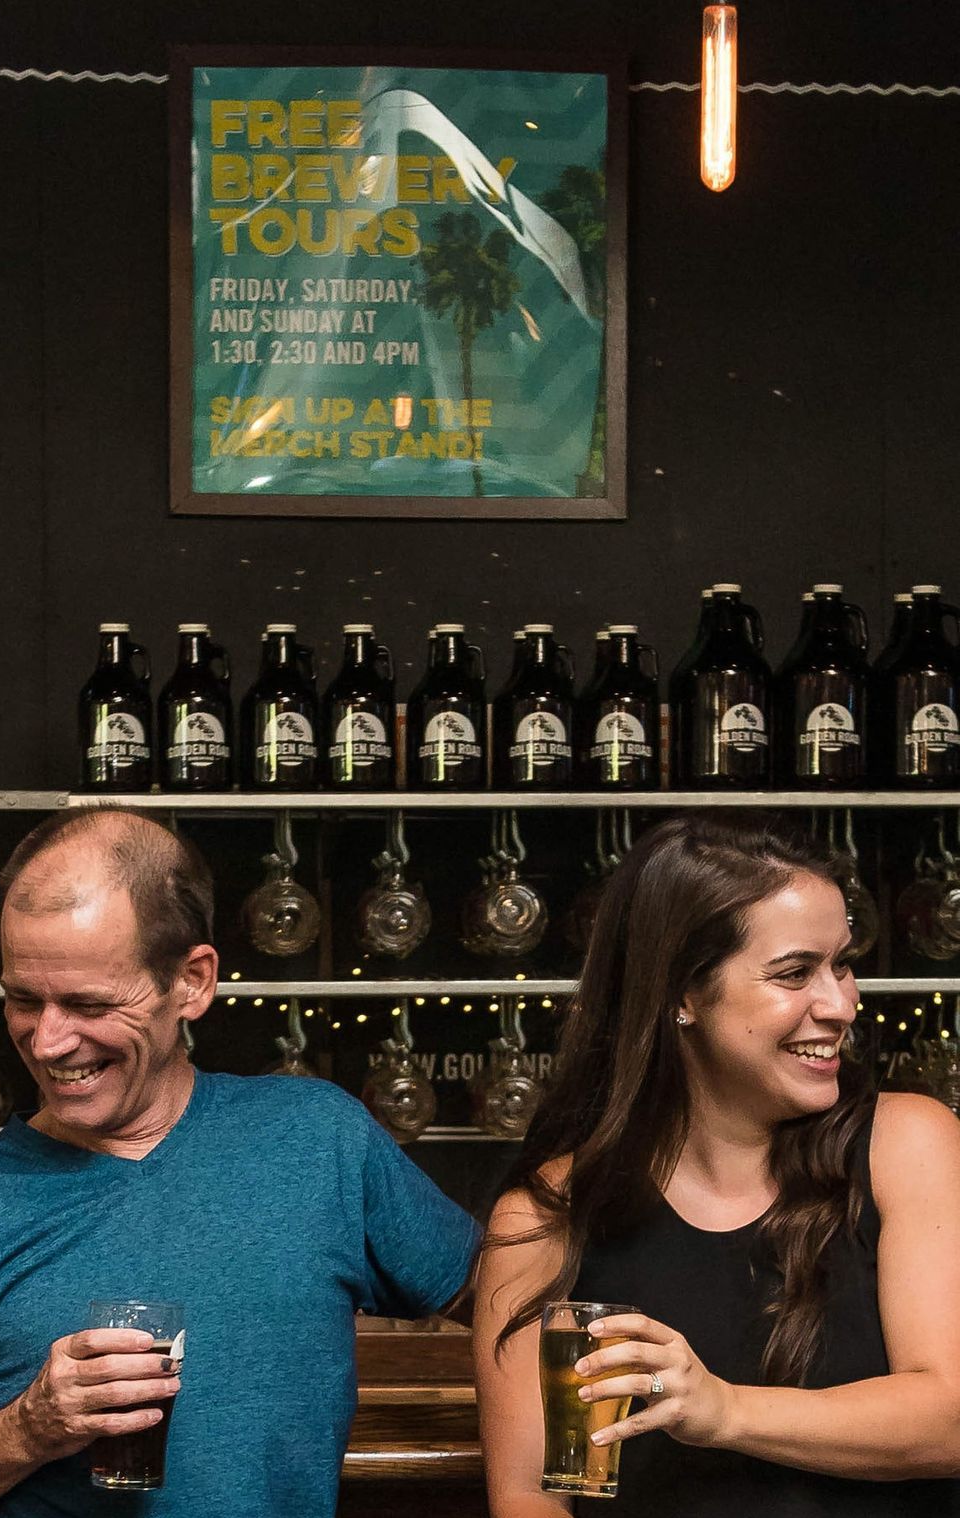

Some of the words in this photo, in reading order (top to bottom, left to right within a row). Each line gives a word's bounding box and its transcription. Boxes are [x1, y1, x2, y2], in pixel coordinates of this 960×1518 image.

[210, 100, 364, 149] FREE
[208, 207, 421, 258] TOURS
[209, 309, 254, 333] AND
[259, 309, 345, 333] SUNDAY
[351, 310, 377, 333] AT
[271, 340, 316, 364] 2:30
[323, 341, 365, 364] AND
[372, 341, 419, 365] 4PM
[306, 397, 354, 425] UP
[420, 398, 492, 427] THE
[348, 431, 484, 462] STAND!
